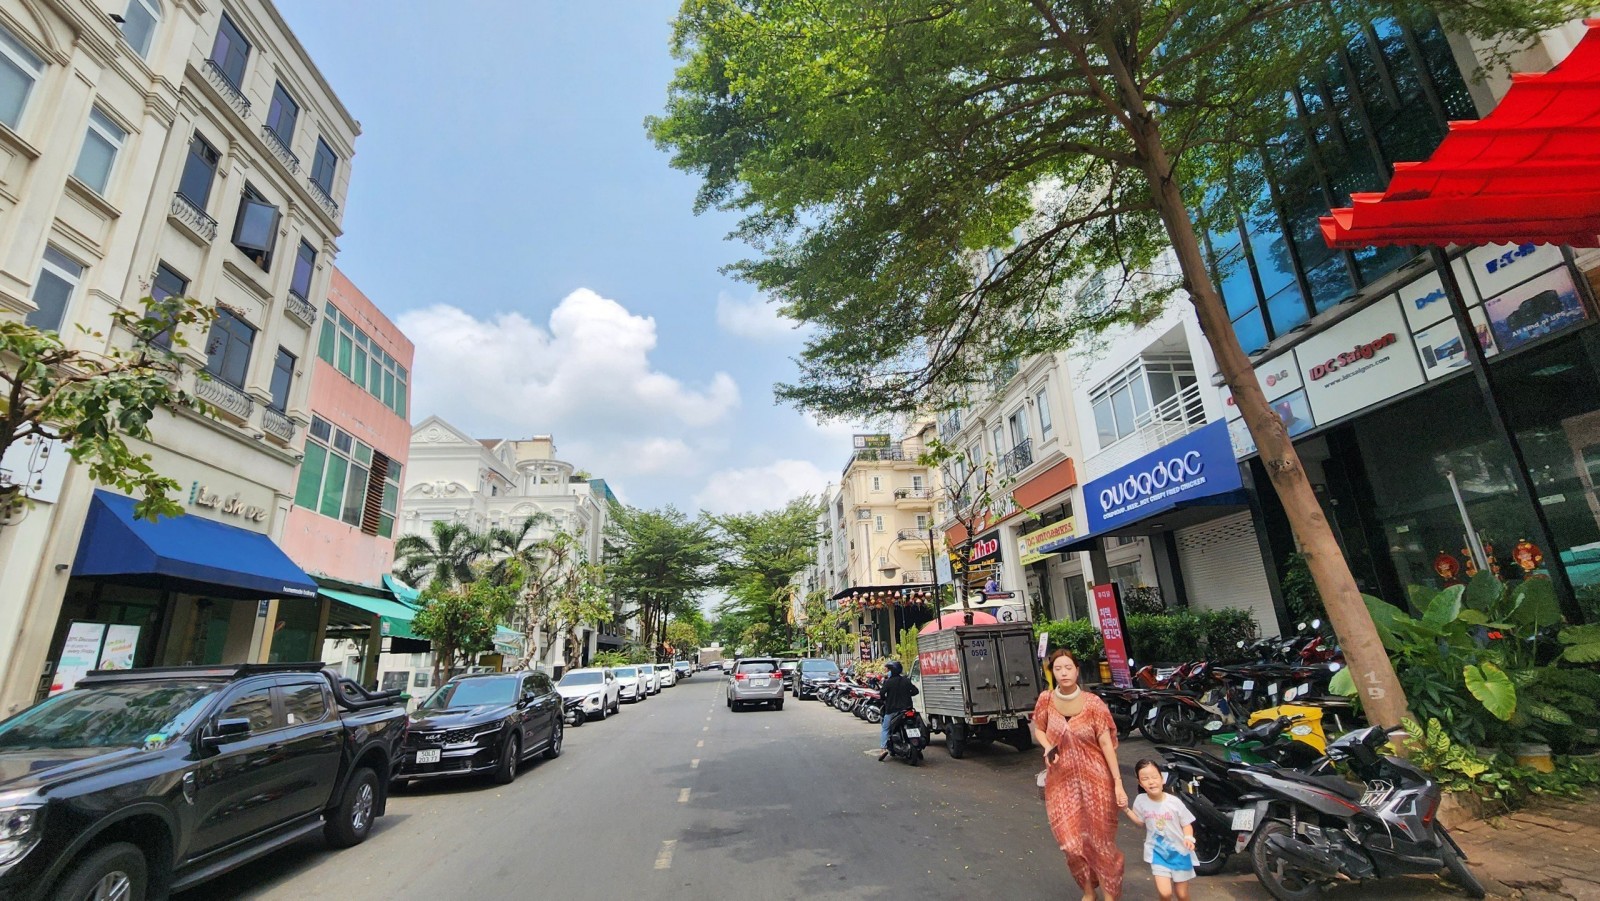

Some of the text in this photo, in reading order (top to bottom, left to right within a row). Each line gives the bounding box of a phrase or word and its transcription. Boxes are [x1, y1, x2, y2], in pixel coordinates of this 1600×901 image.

[1415, 288, 1447, 310] DEL
[1309, 333, 1397, 381] IDC Saigon
[1324, 355, 1391, 389] www.idcsaigon.com
[196, 485, 222, 508] La
[1165, 486, 1181, 498] FRIED
[1180, 476, 1207, 491] CHICKEN
[302, 589, 316, 598] bakery
[971, 649, 988, 657] 0502
